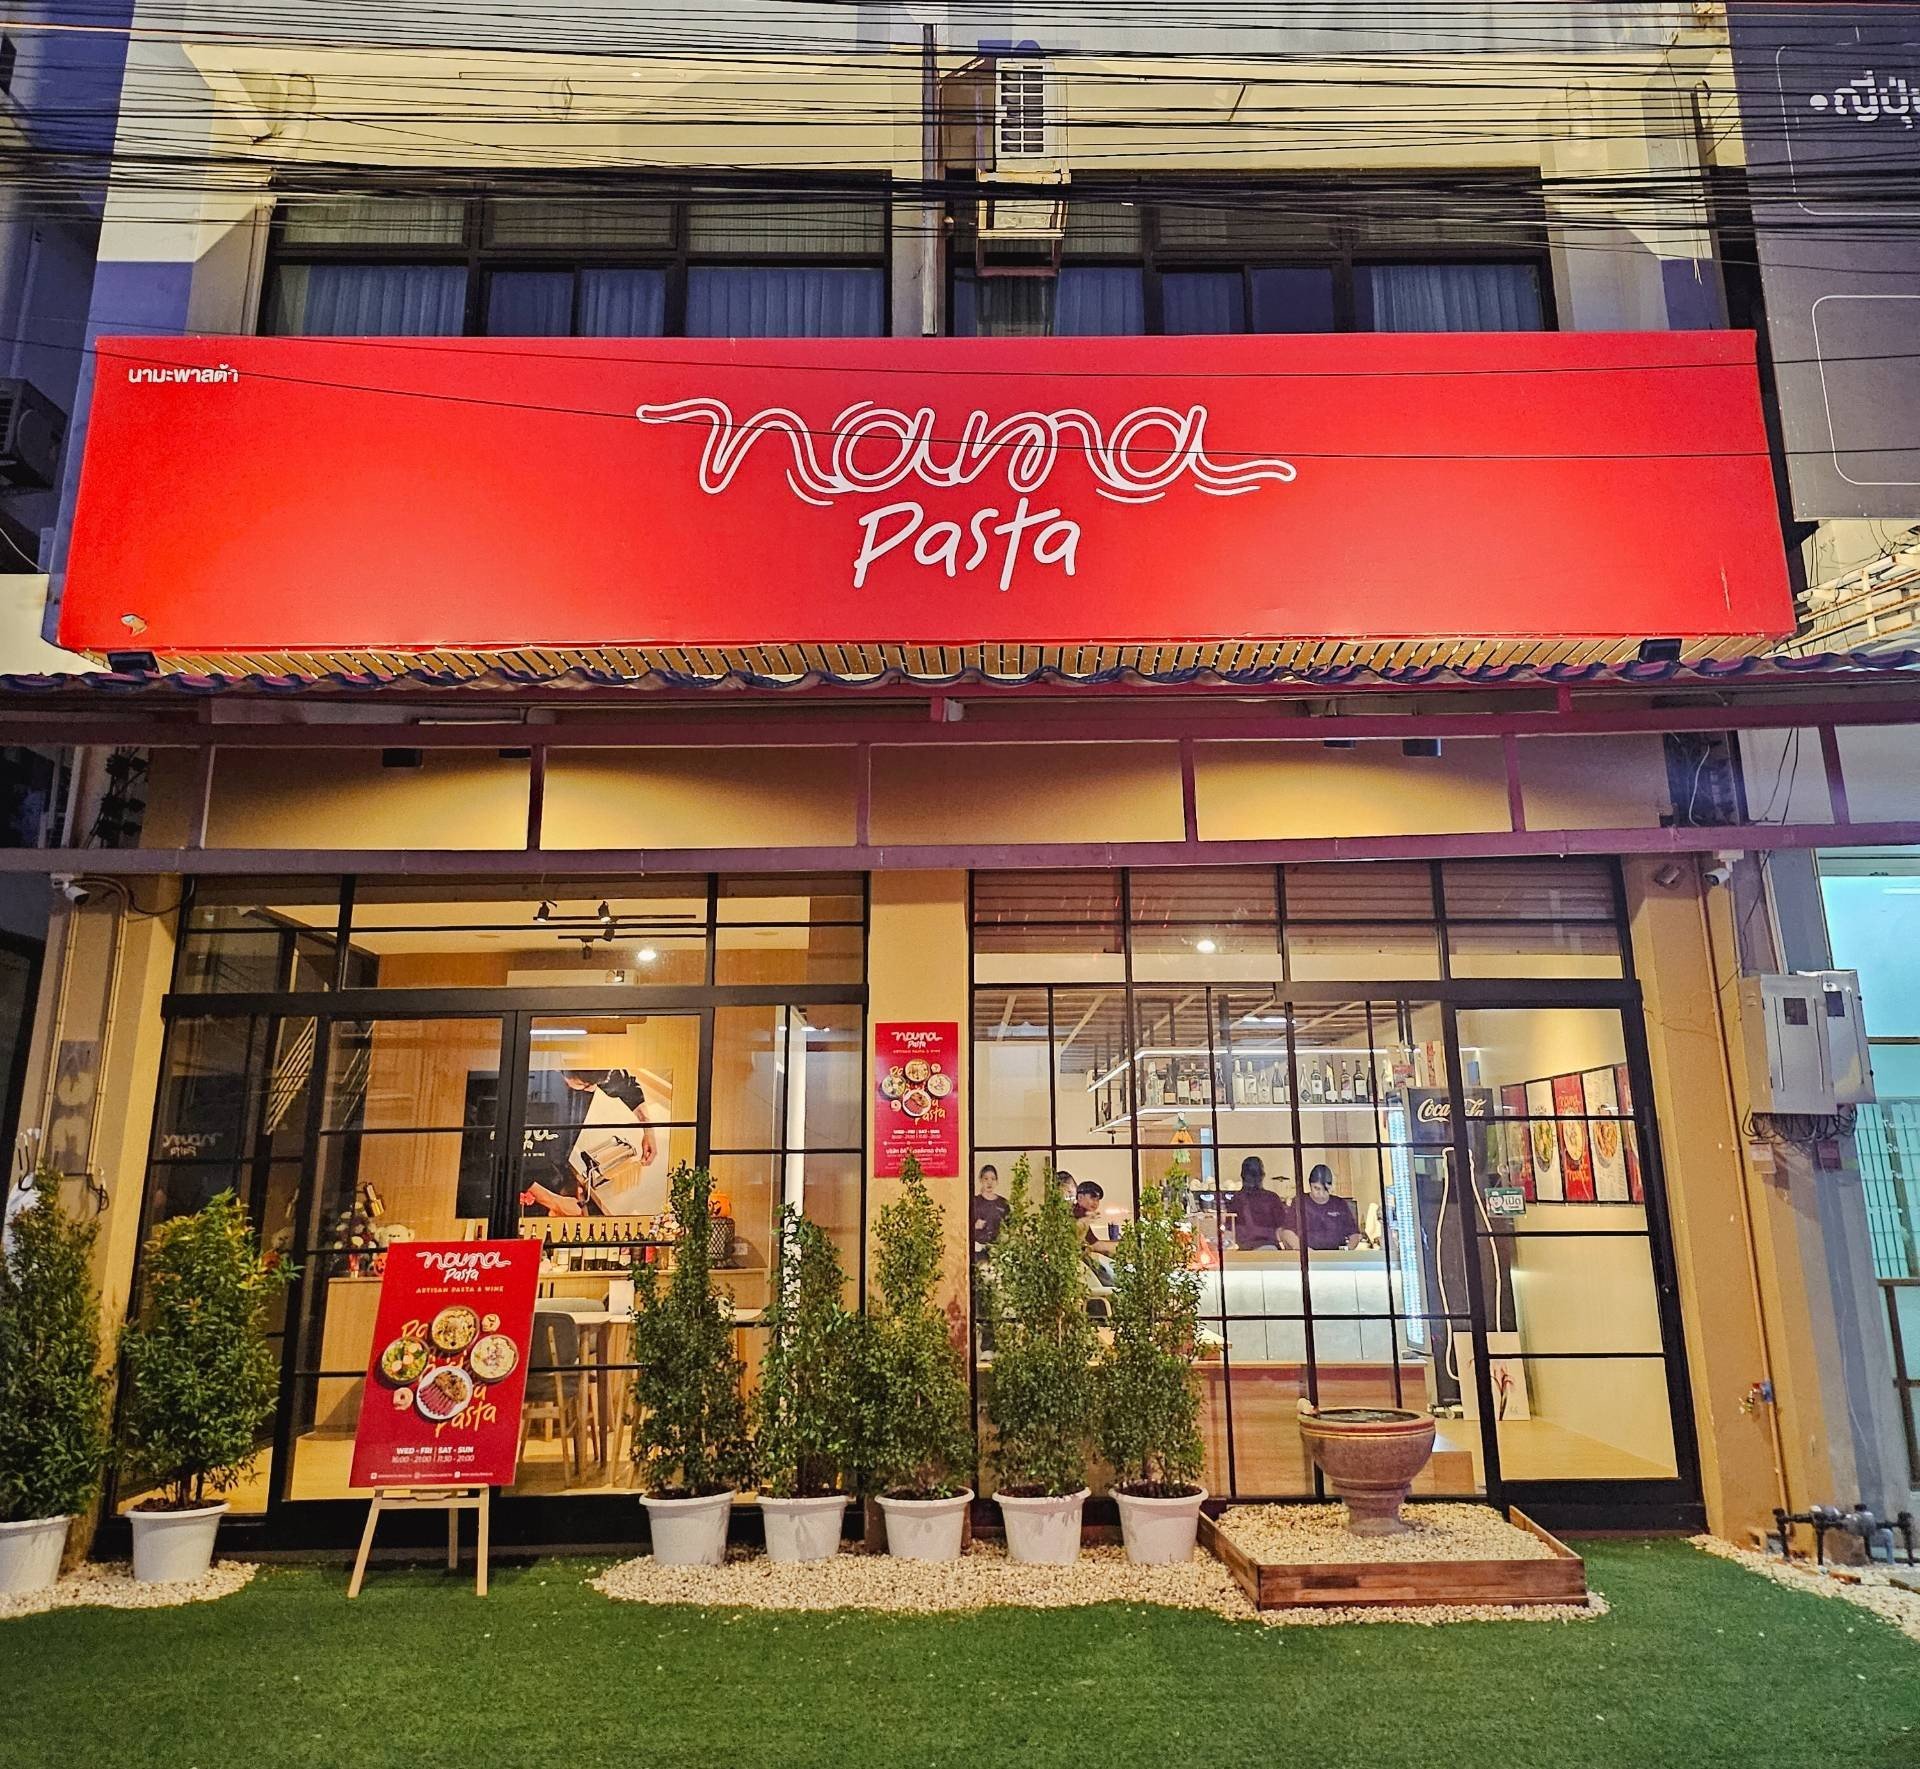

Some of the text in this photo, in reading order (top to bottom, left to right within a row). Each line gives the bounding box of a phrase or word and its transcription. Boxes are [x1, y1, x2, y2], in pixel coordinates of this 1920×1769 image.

[127, 363, 239, 384] นามะพาสต้า
[636, 397, 1297, 505] nama
[853, 497, 1082, 592] Pasta
[416, 1251, 512, 1270] nama
